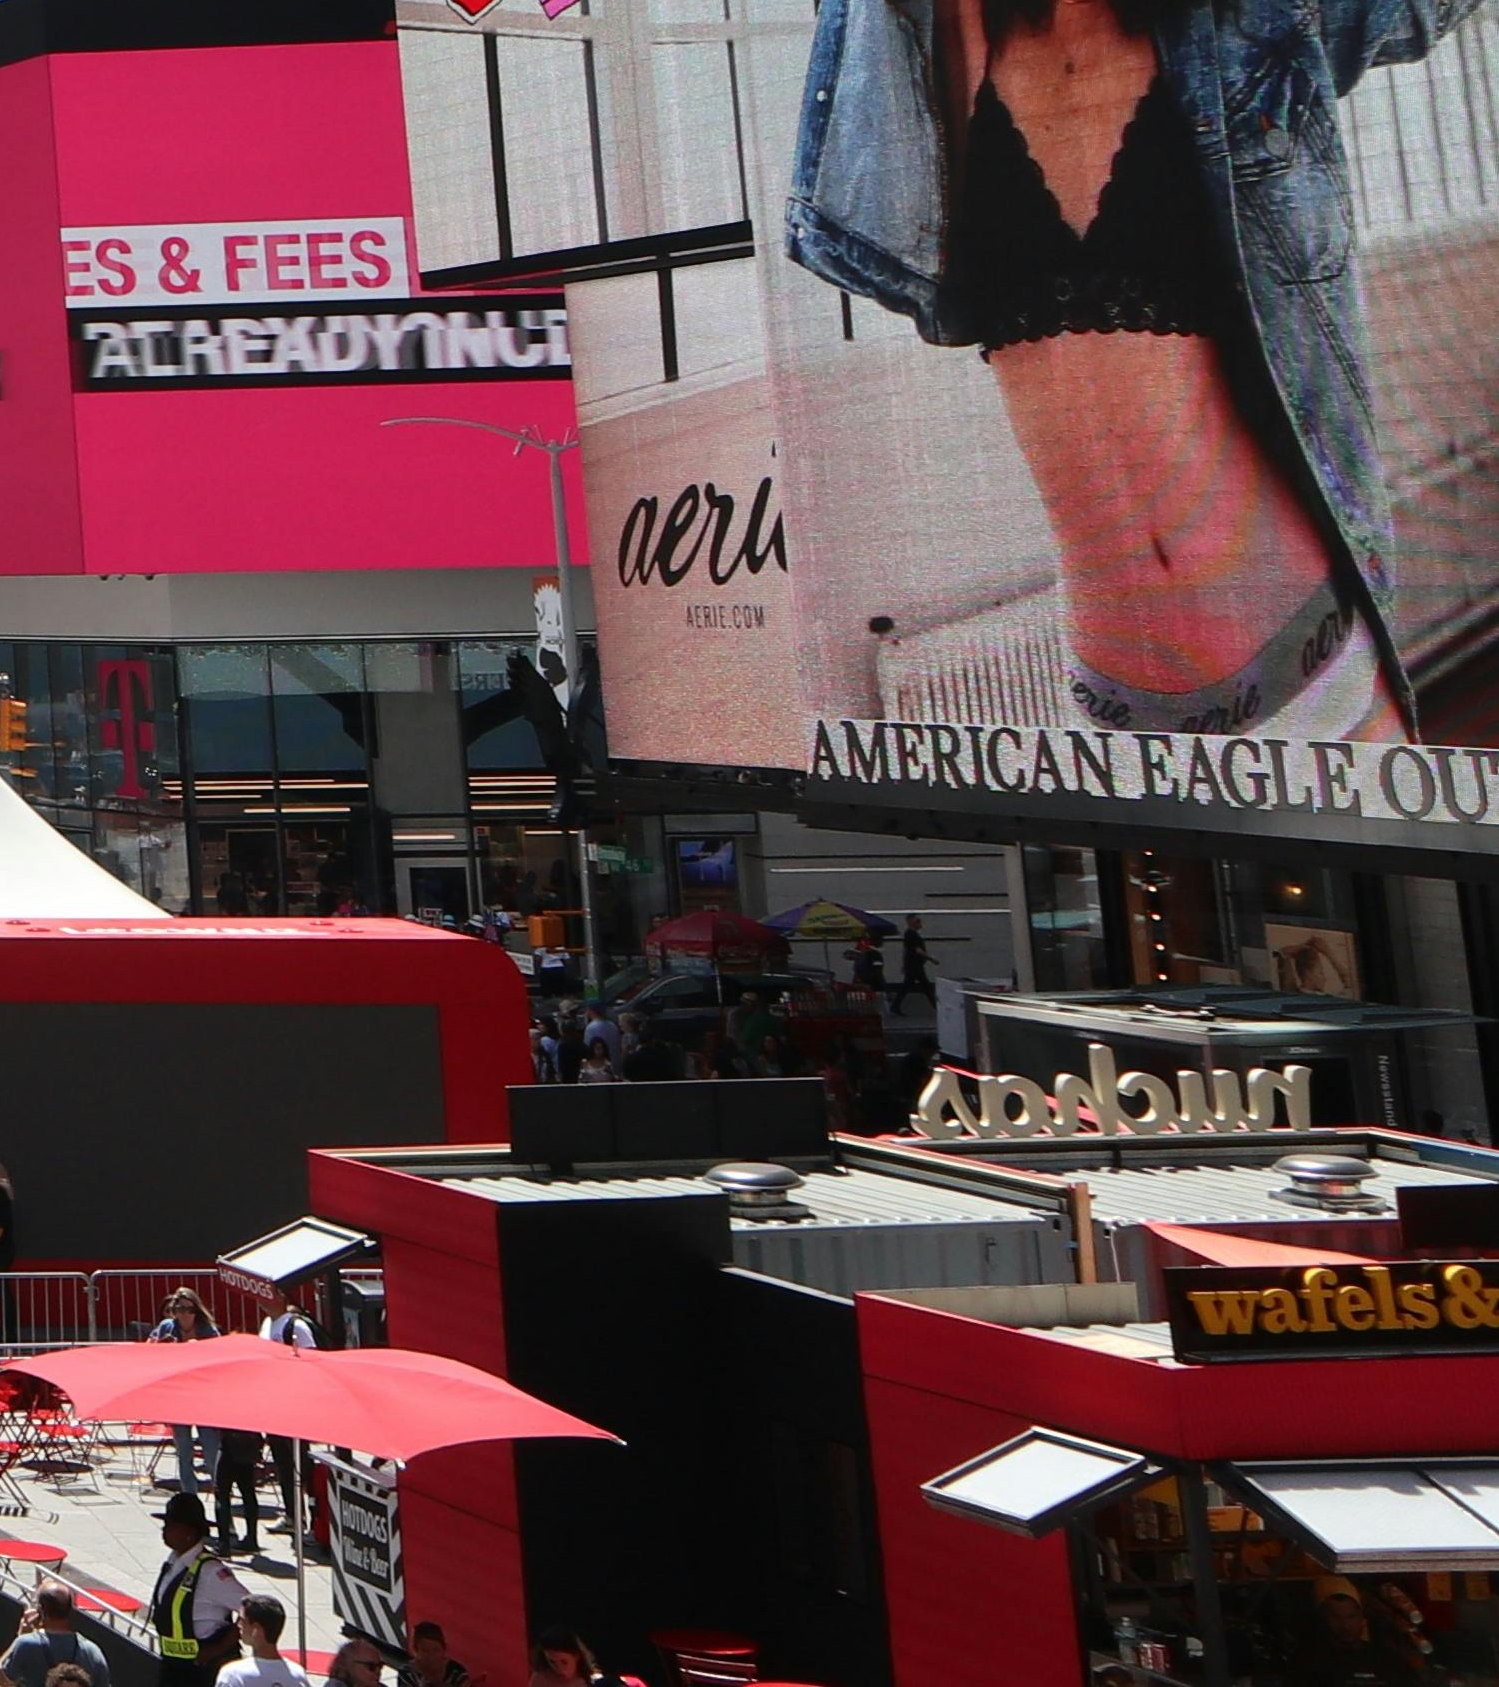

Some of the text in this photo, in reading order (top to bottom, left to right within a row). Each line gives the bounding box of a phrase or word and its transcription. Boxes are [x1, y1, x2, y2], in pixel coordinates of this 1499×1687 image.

[158, 229, 393, 295] & FEES
[686, 604, 765, 630] AERIE.COM
[811, 720, 1362, 818] AMERICAN EAGLE
[1377, 1054, 1398, 1127] Newsstand
[218, 1266, 274, 1301] HOTDOGS
[1186, 1266, 1440, 1337] wafels
[341, 1496, 388, 1544] HOTDOGS
[342, 1533, 389, 1580] Wine Beer
